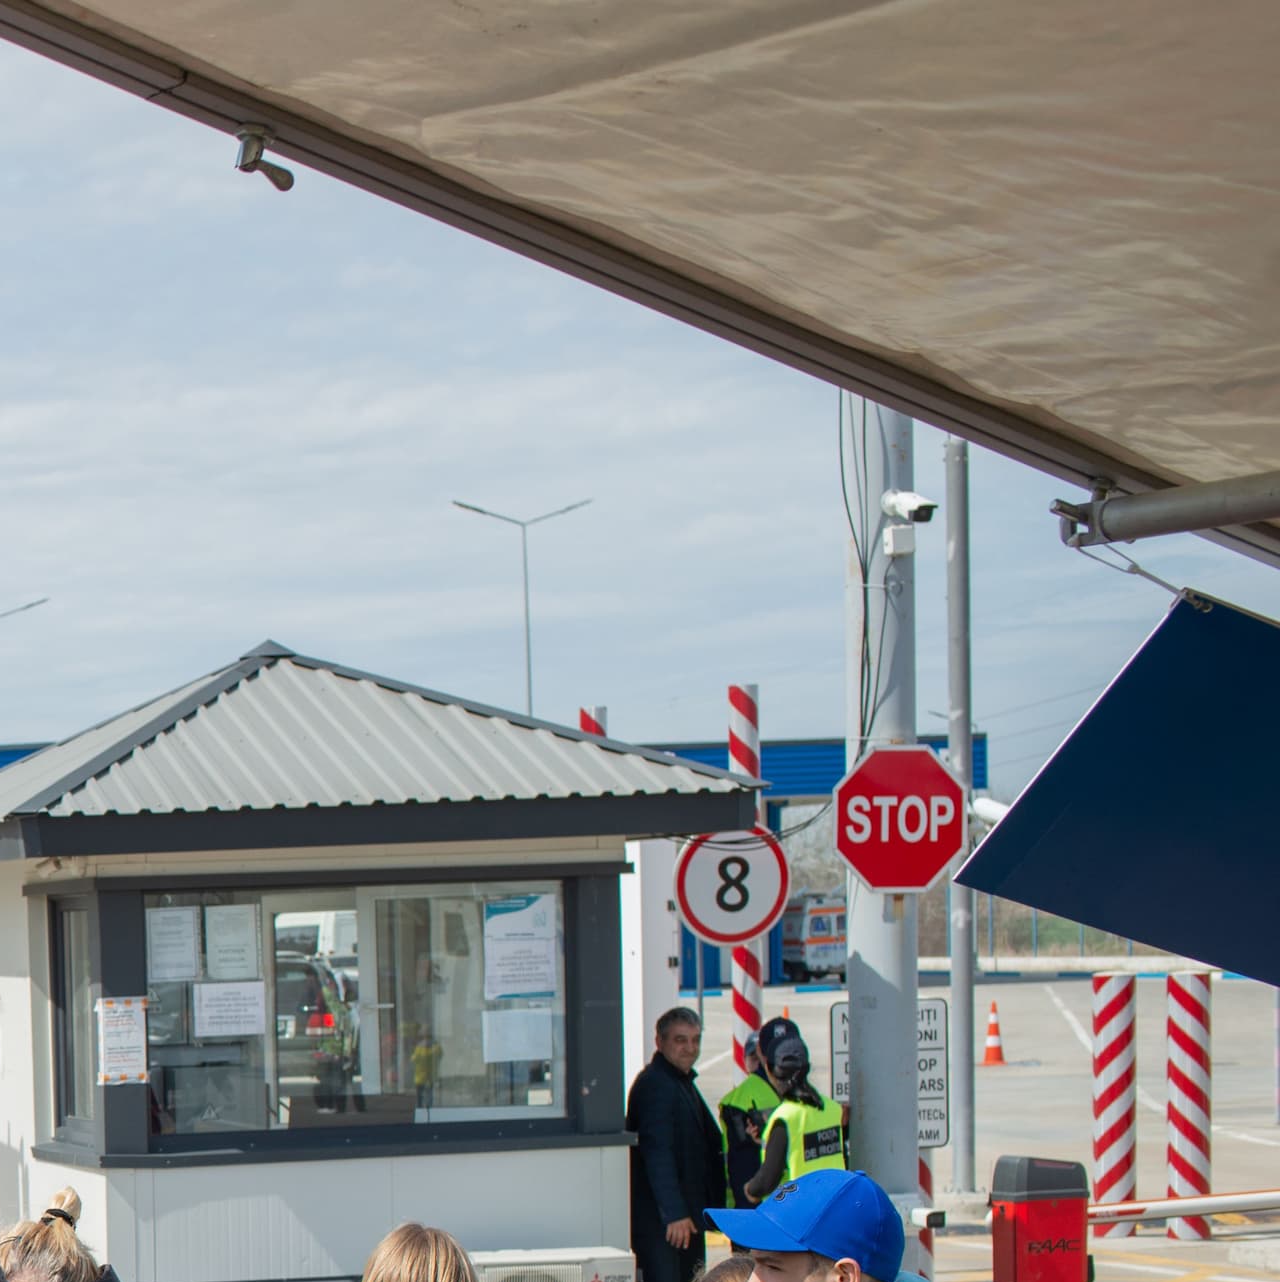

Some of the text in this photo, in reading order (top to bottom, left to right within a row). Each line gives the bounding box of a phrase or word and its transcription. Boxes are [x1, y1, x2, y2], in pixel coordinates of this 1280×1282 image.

[845, 795, 955, 844] STOP
[716, 856, 750, 912] 8
[919, 1078, 945, 1092] ARS
